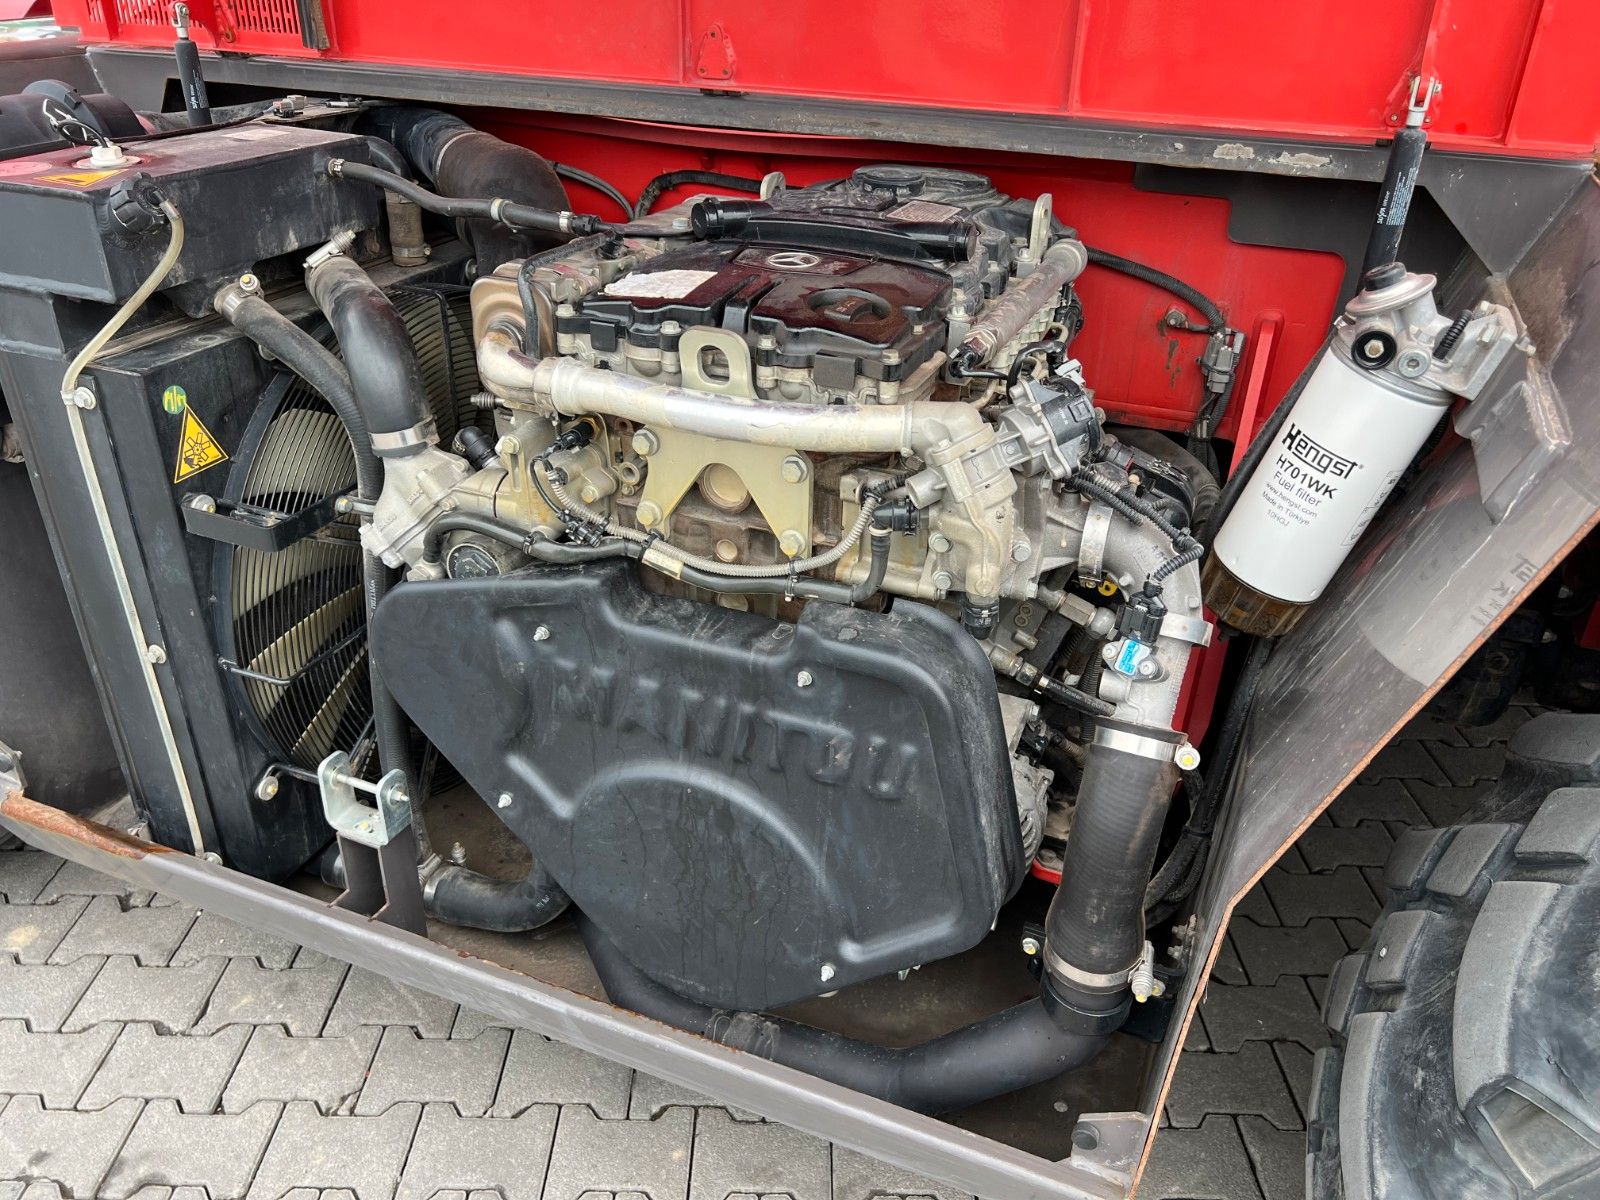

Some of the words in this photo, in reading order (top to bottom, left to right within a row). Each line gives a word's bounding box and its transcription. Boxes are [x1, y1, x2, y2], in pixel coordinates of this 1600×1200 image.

[1281, 422, 1358, 480] Hengst
[1273, 470, 1296, 492] Fuel
[1295, 488, 1322, 507] filter
[1276, 454, 1338, 499] H701WK
[1262, 490, 1277, 506] Made
[1277, 503, 1284, 511] in
[1266, 483, 1318, 518] www.hengst.com
